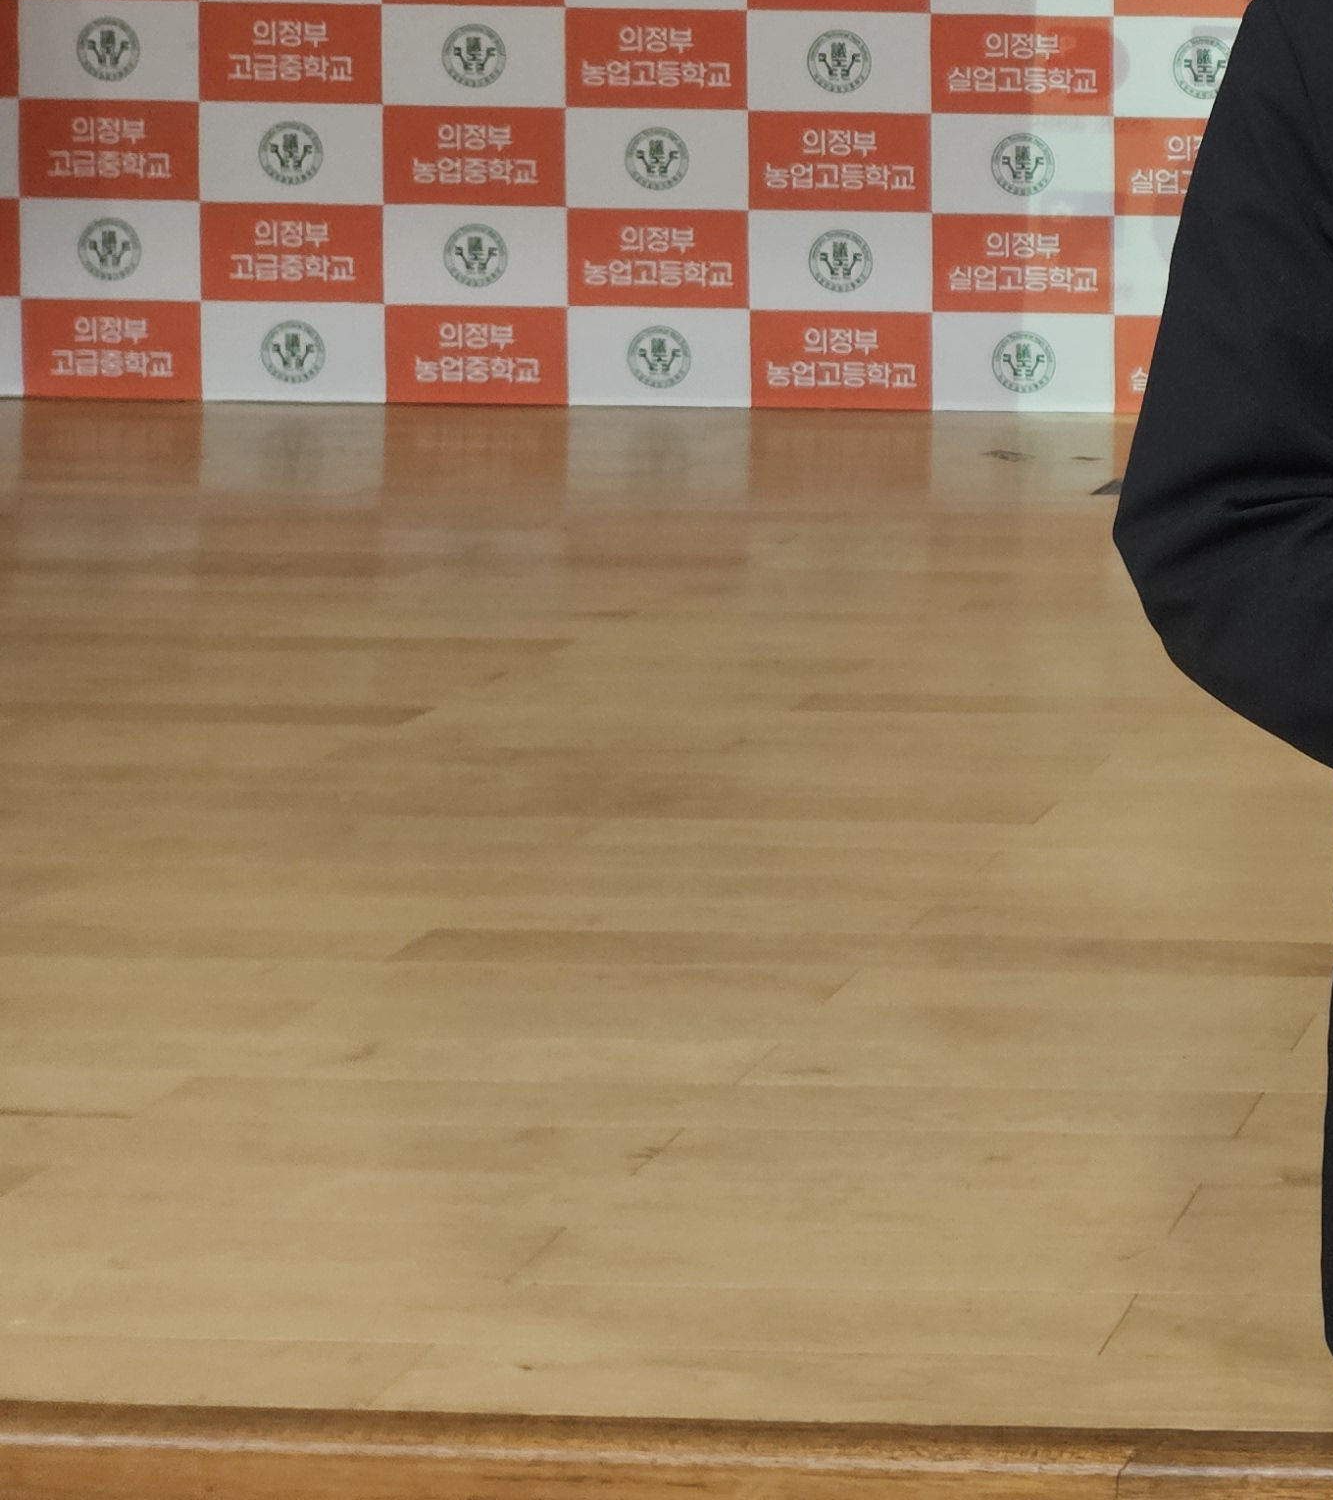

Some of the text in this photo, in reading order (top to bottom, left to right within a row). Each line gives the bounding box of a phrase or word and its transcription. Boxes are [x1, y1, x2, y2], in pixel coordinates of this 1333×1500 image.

[985, 32, 1060, 60] 의정부
[947, 64, 1098, 96] 실업고등학교
[437, 123, 513, 151] 의정부
[801, 128, 877, 157] 의정부
[254, 220, 329, 249] 의정부
[986, 231, 1061, 260] 의정부
[949, 264, 1099, 293] 실업고등학교
